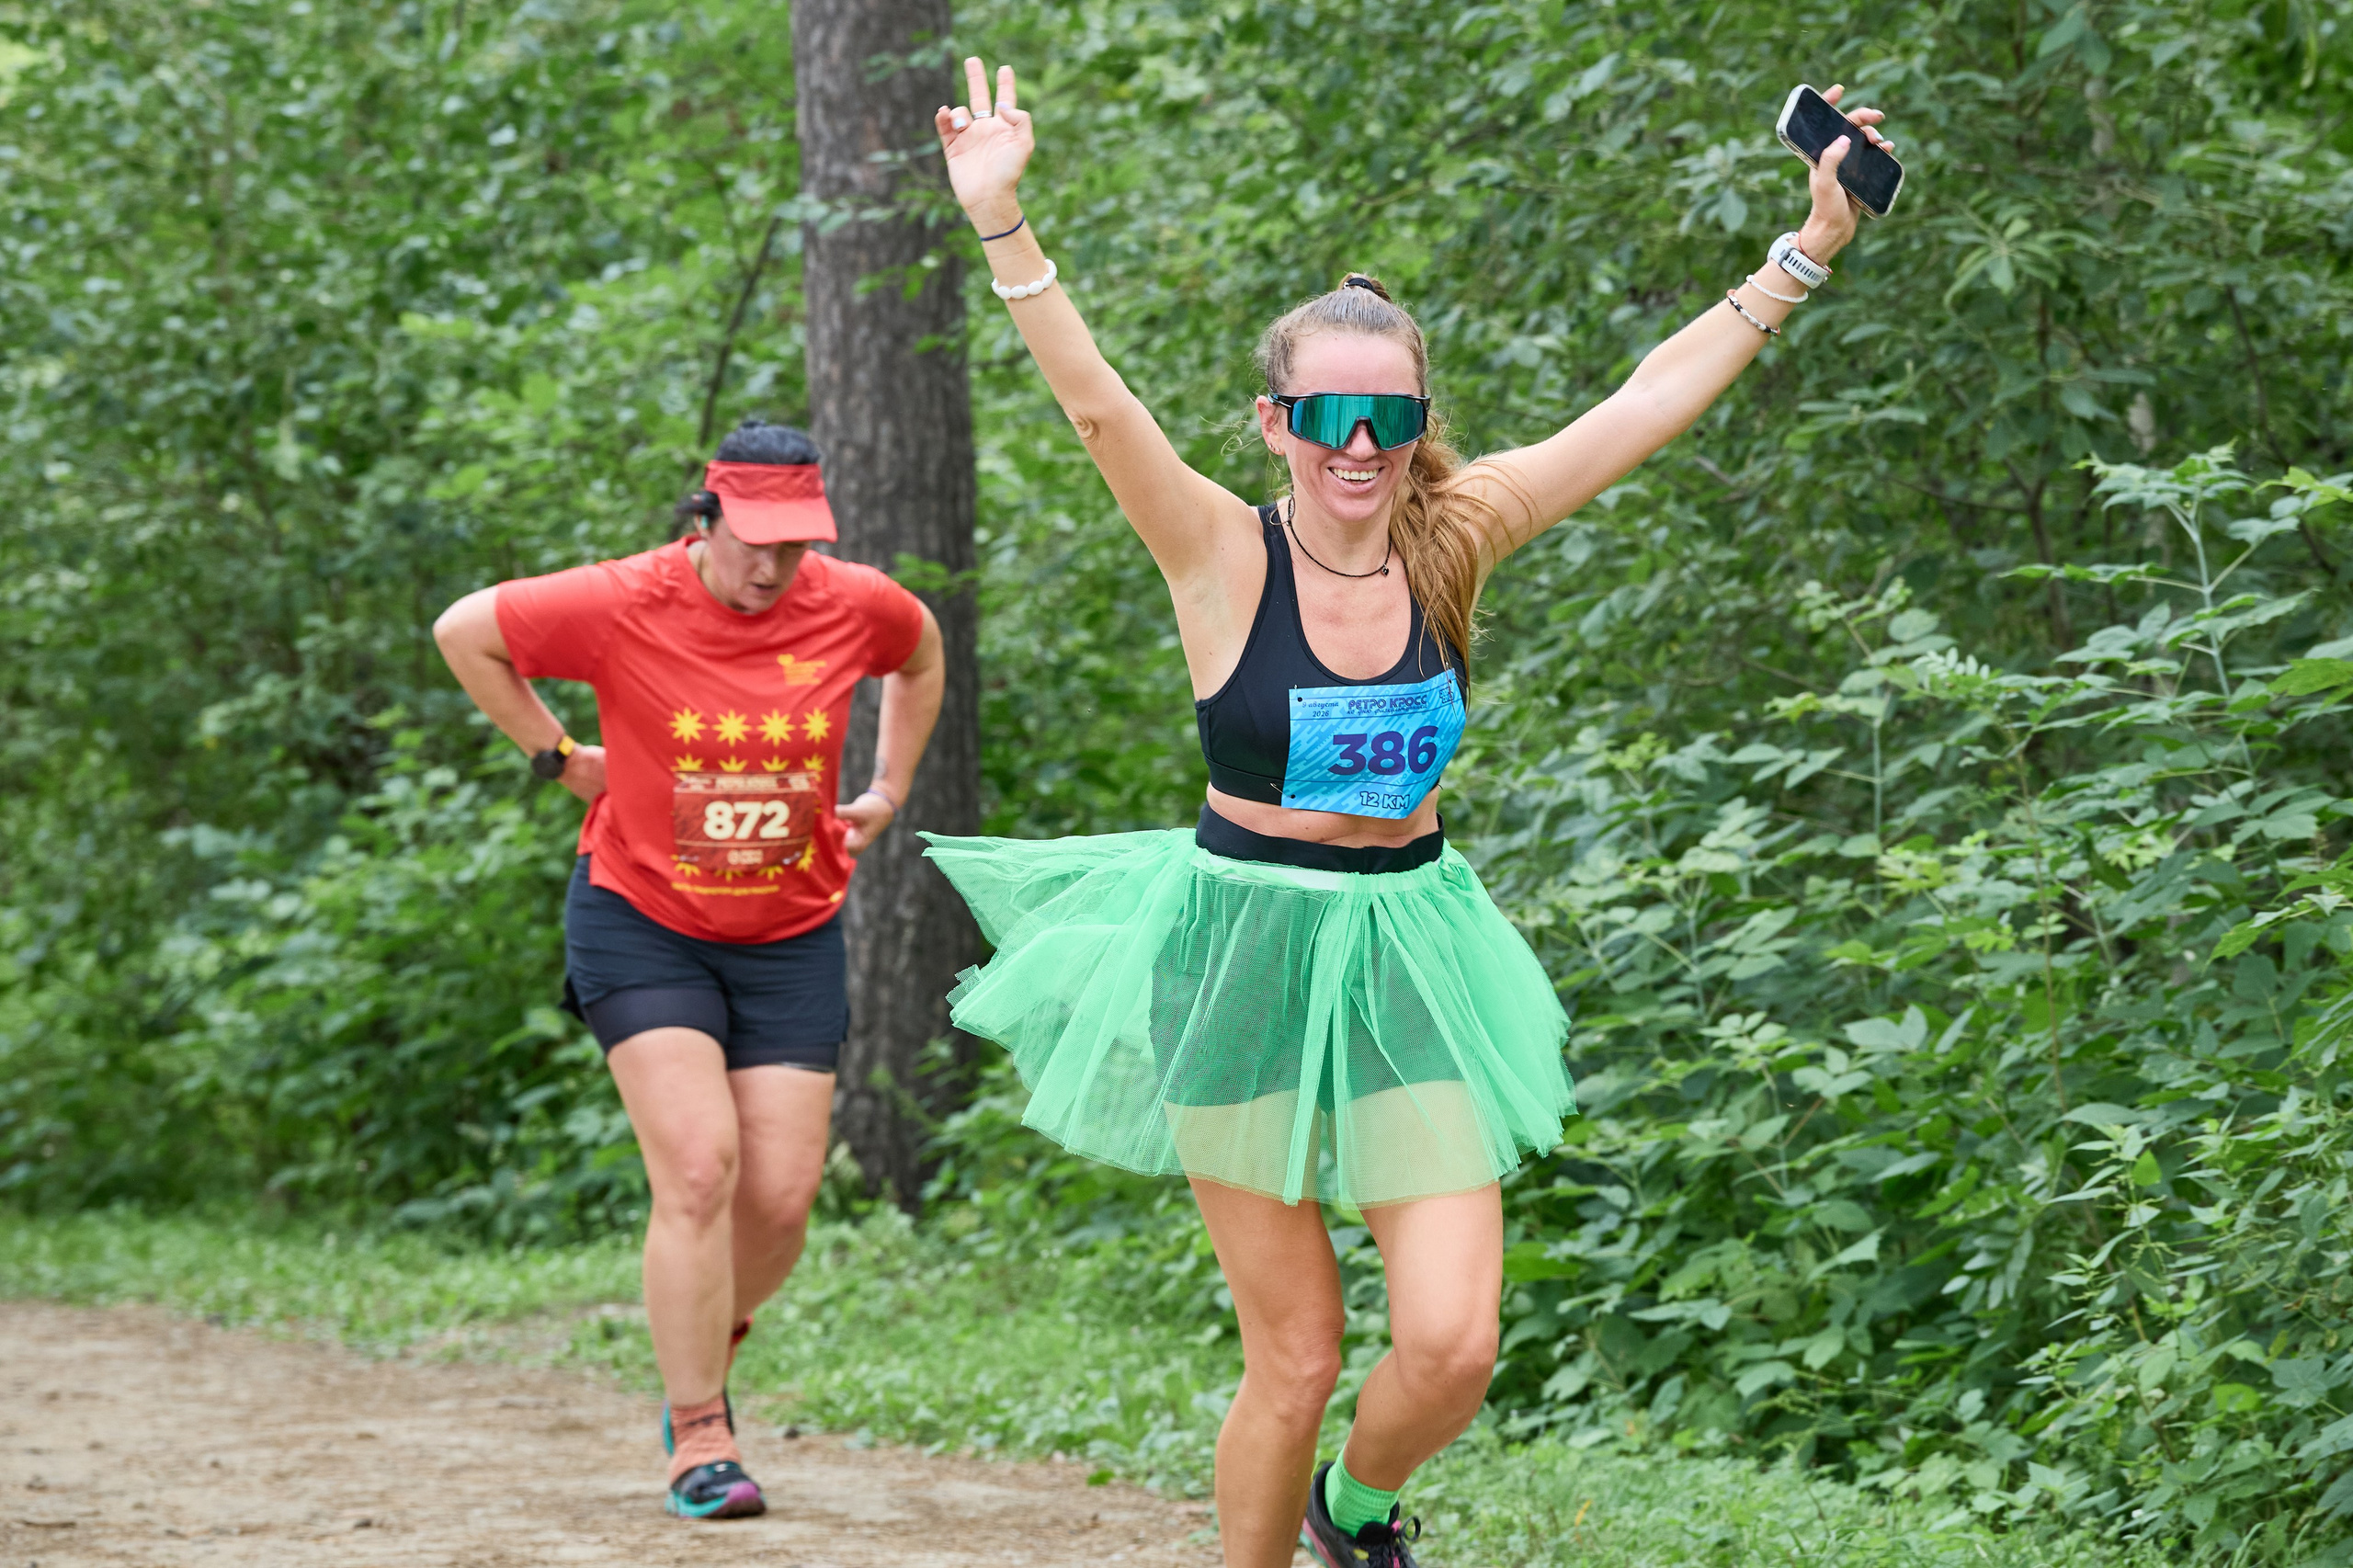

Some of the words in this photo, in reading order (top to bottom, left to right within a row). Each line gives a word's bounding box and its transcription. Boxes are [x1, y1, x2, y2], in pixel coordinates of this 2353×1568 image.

[1348, 699, 1386, 710] РЕТРО
[1390, 695, 1427, 708] КРОСС
[1327, 725, 1439, 776] 386
[1359, 790, 1380, 808] 12
[1381, 793, 1411, 810] КМ
[703, 801, 790, 840] 872
